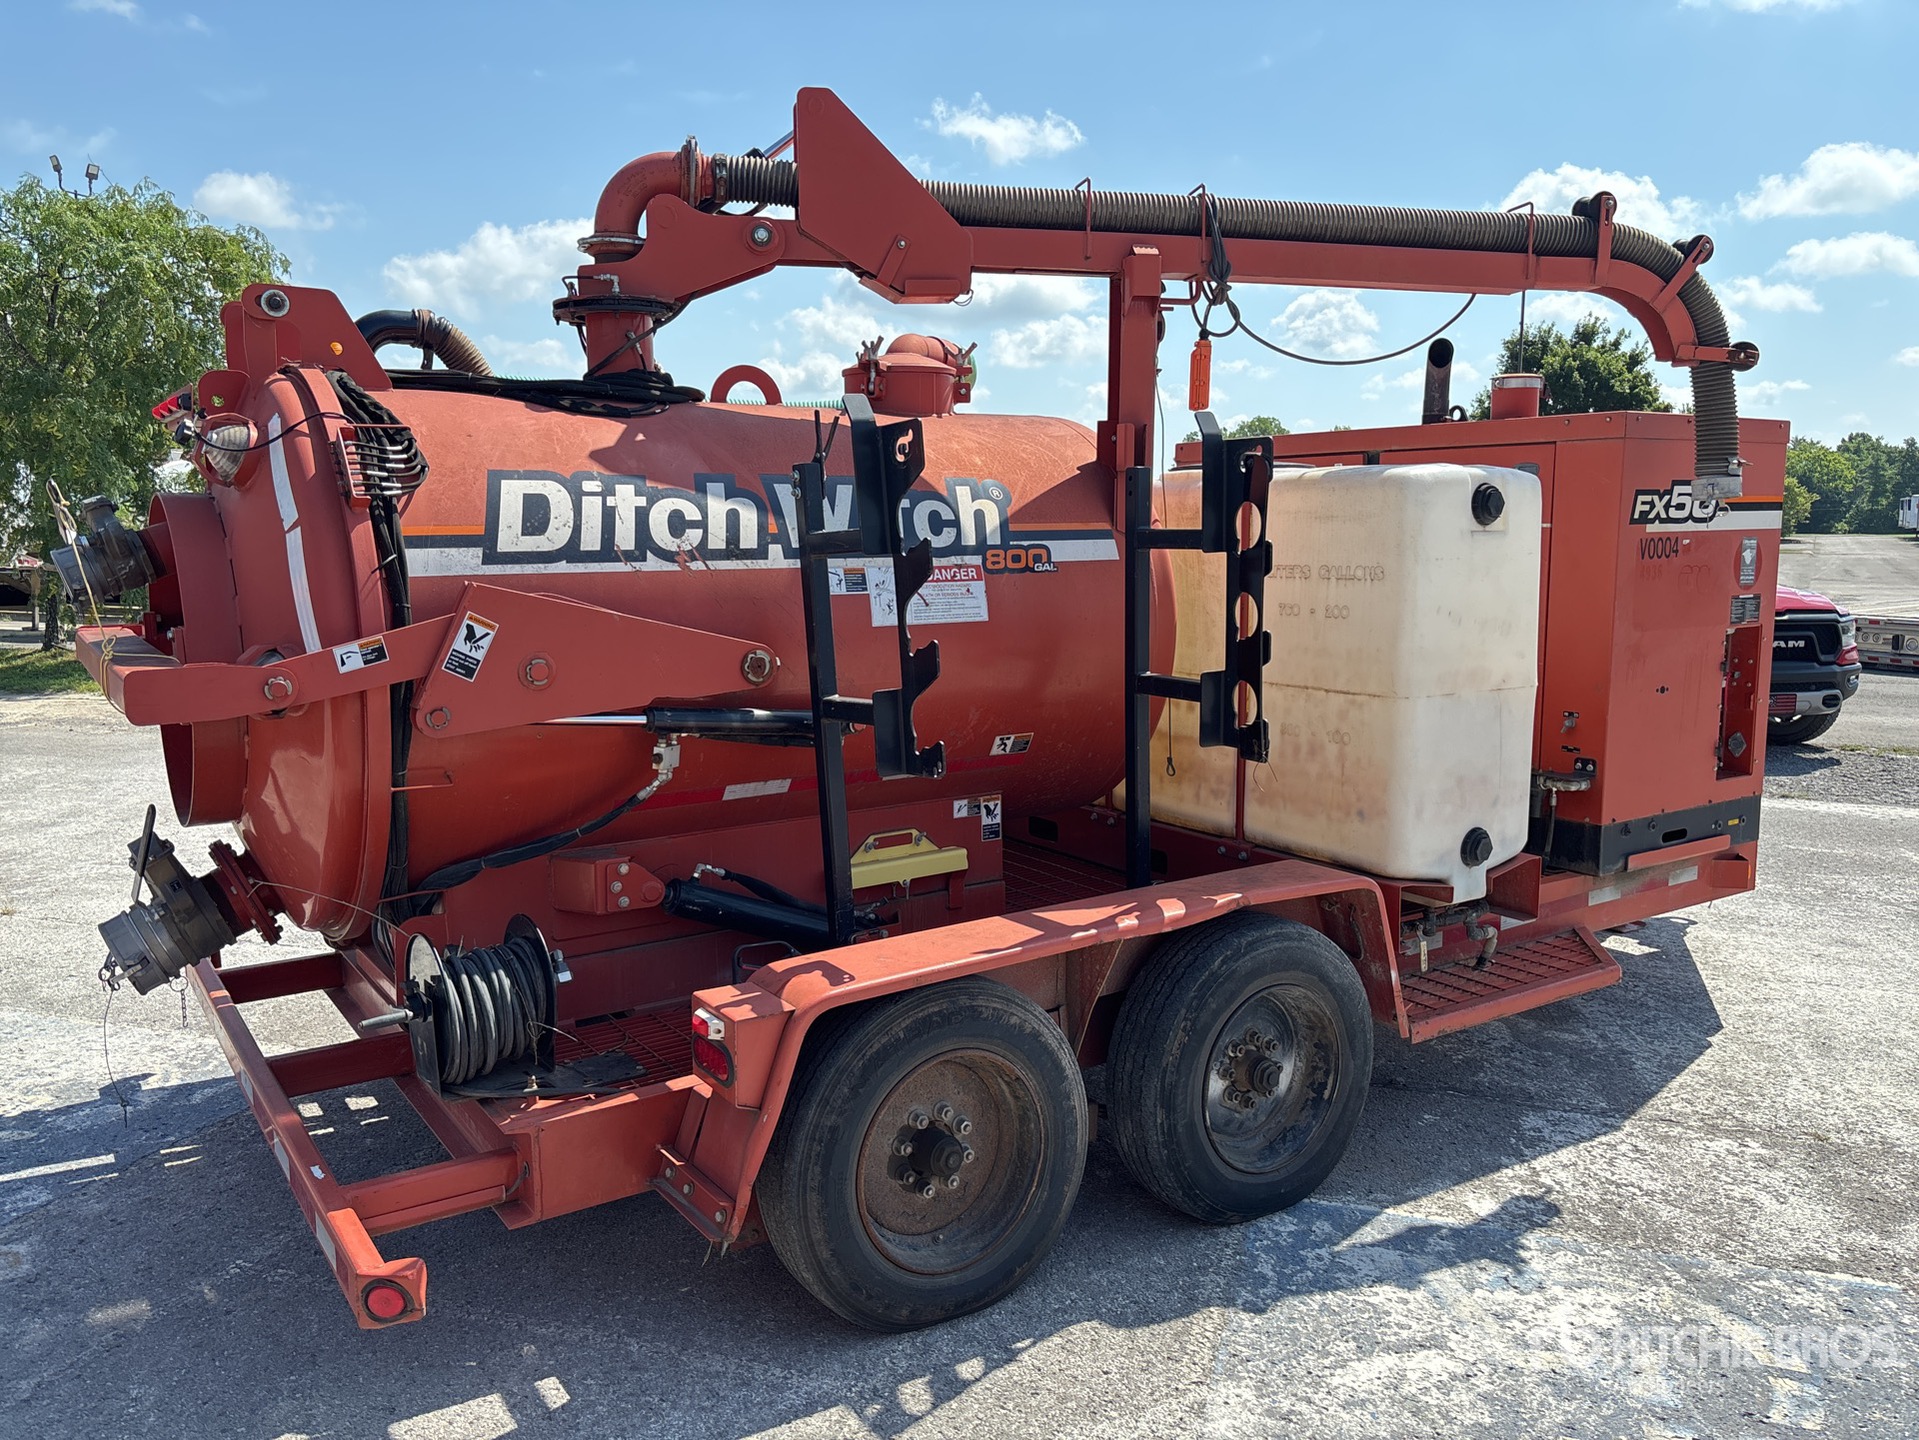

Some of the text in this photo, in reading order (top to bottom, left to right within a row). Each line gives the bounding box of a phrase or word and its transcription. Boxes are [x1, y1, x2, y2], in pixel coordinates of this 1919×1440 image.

[497, 480, 758, 552] Ditch
[986, 549, 1048, 570] 800
[1318, 564, 1384, 581] GALLONS
[1772, 640, 1805, 648] AM
